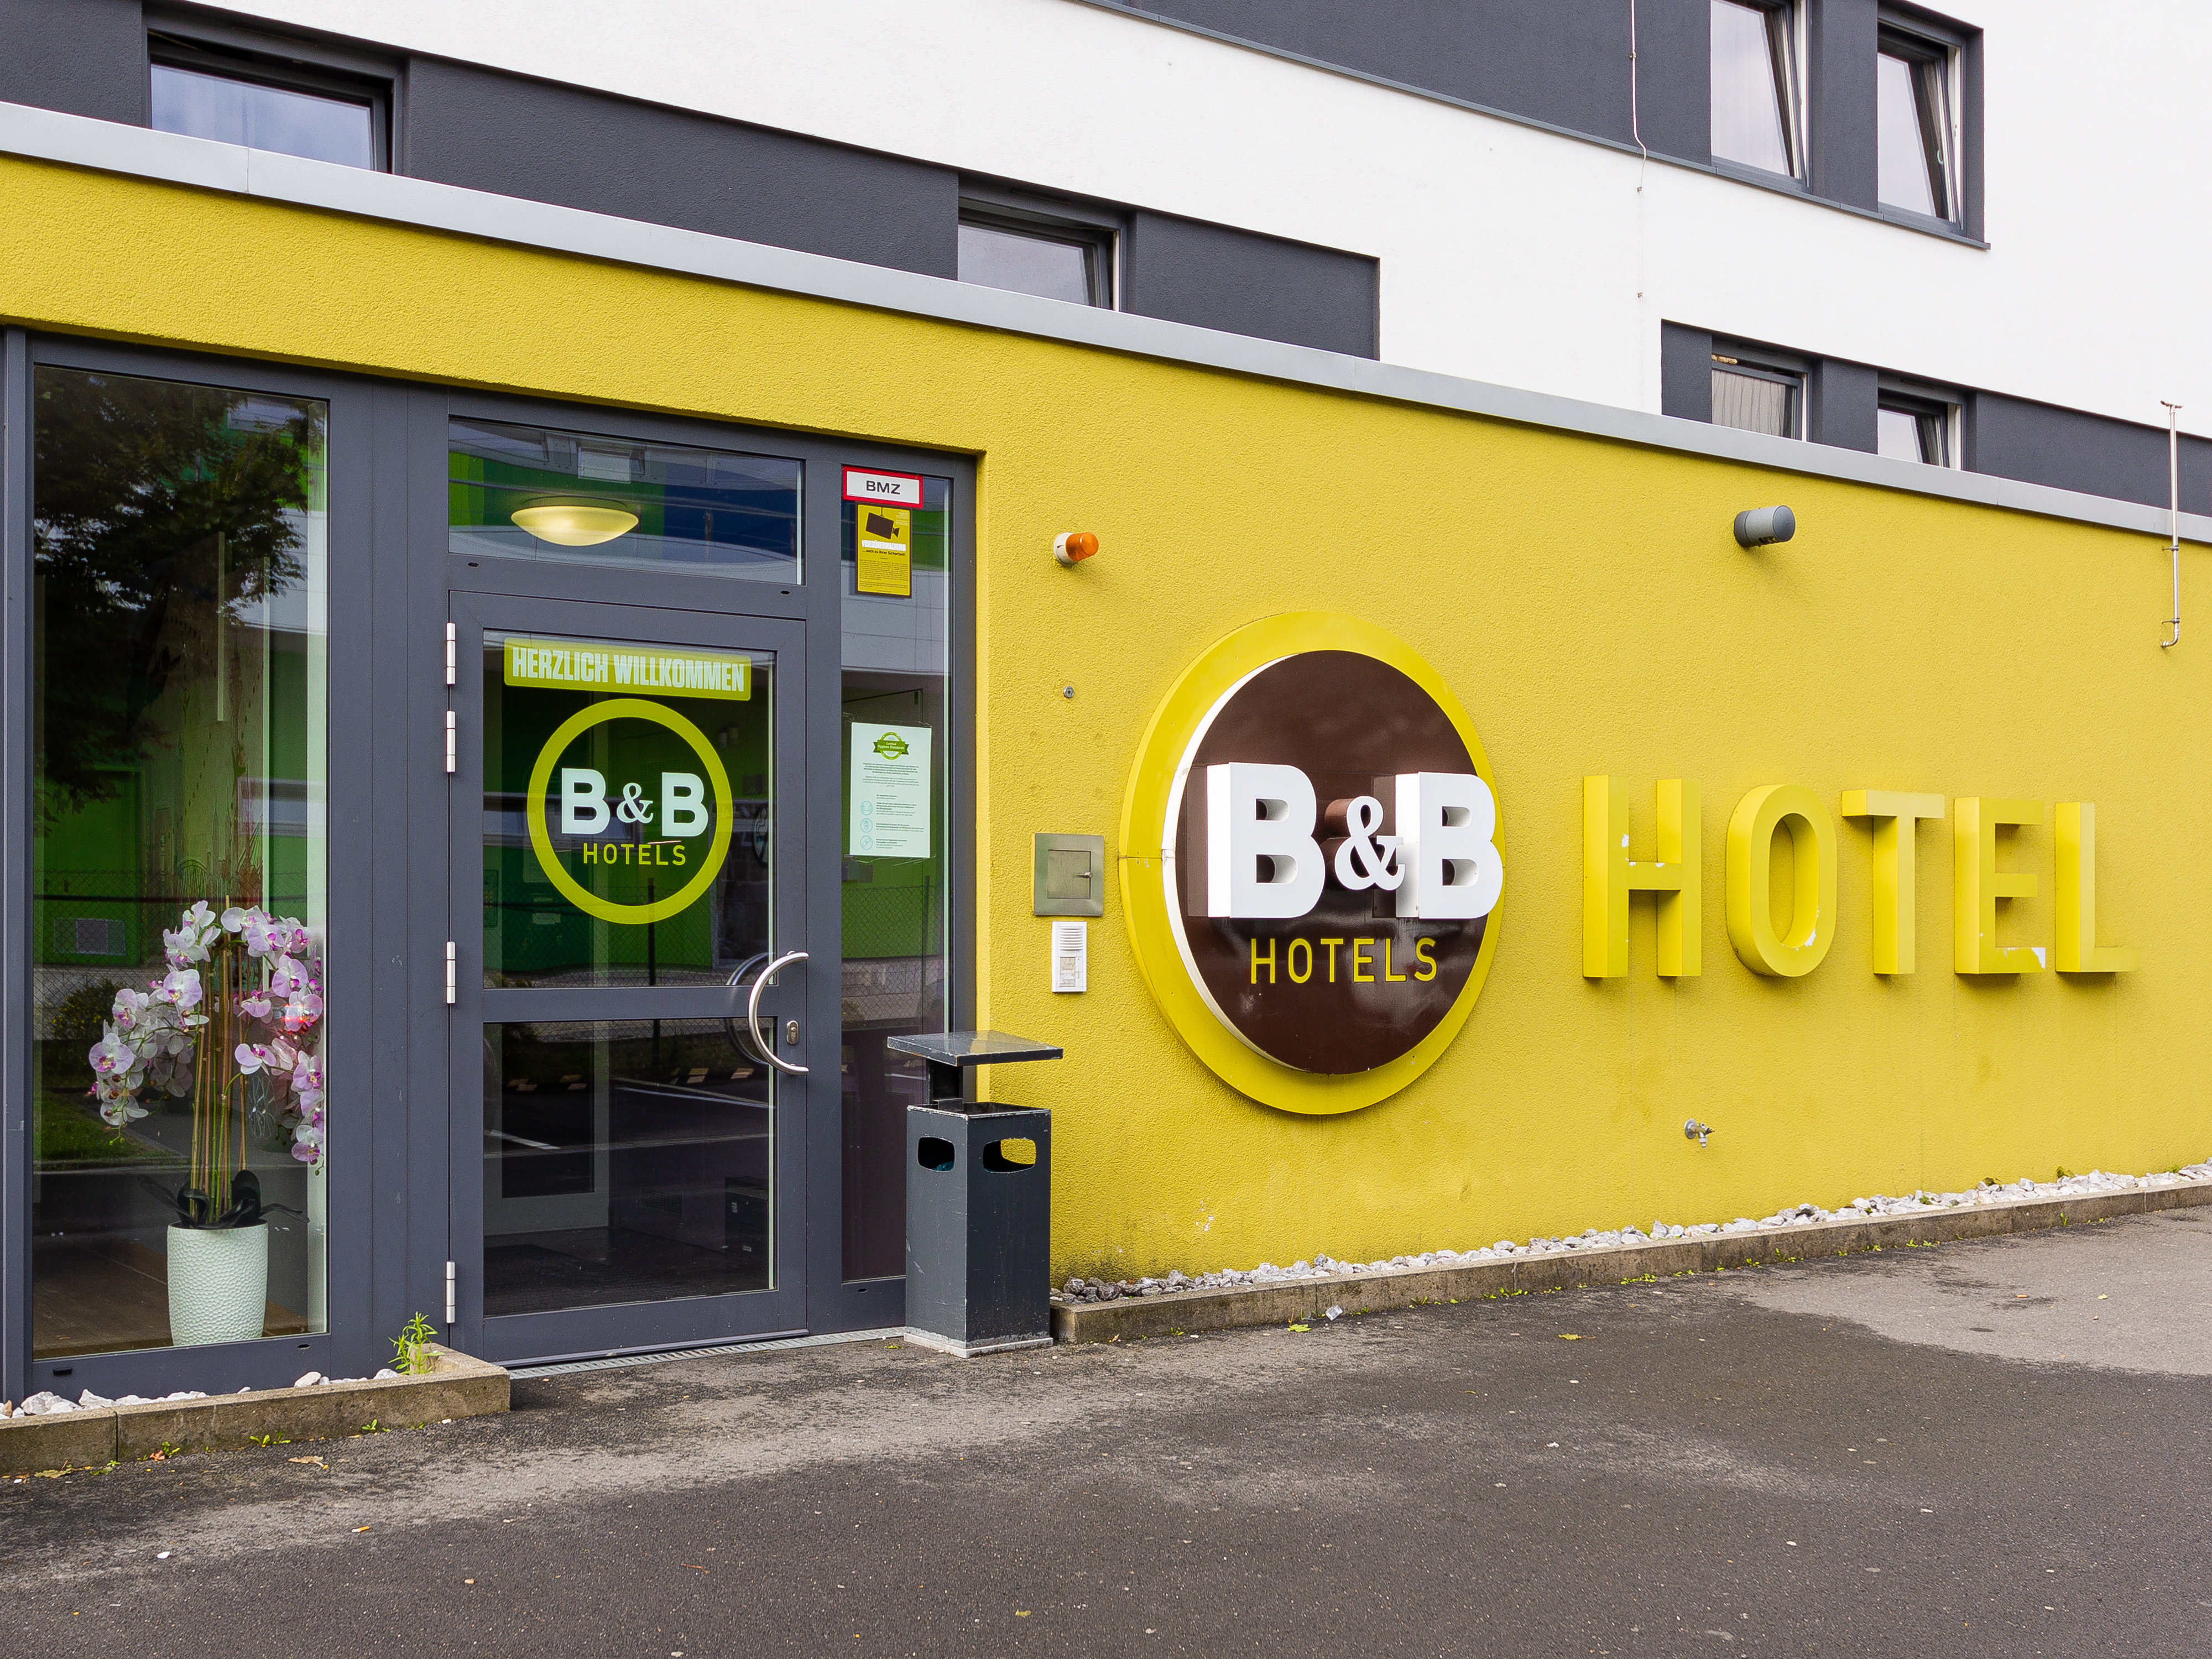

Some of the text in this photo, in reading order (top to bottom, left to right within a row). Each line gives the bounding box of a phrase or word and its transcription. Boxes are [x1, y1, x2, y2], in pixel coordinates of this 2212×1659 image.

[866, 480, 901, 495] BMZ
[512, 647, 744, 692] HERZLICH WILLKOMMEN
[561, 768, 708, 837] B&B
[583, 843, 686, 865] HOTELS
[1207, 761, 1504, 919] B&B
[1583, 774, 2139, 978] HOTEL
[1250, 937, 1438, 984] HOTELS
